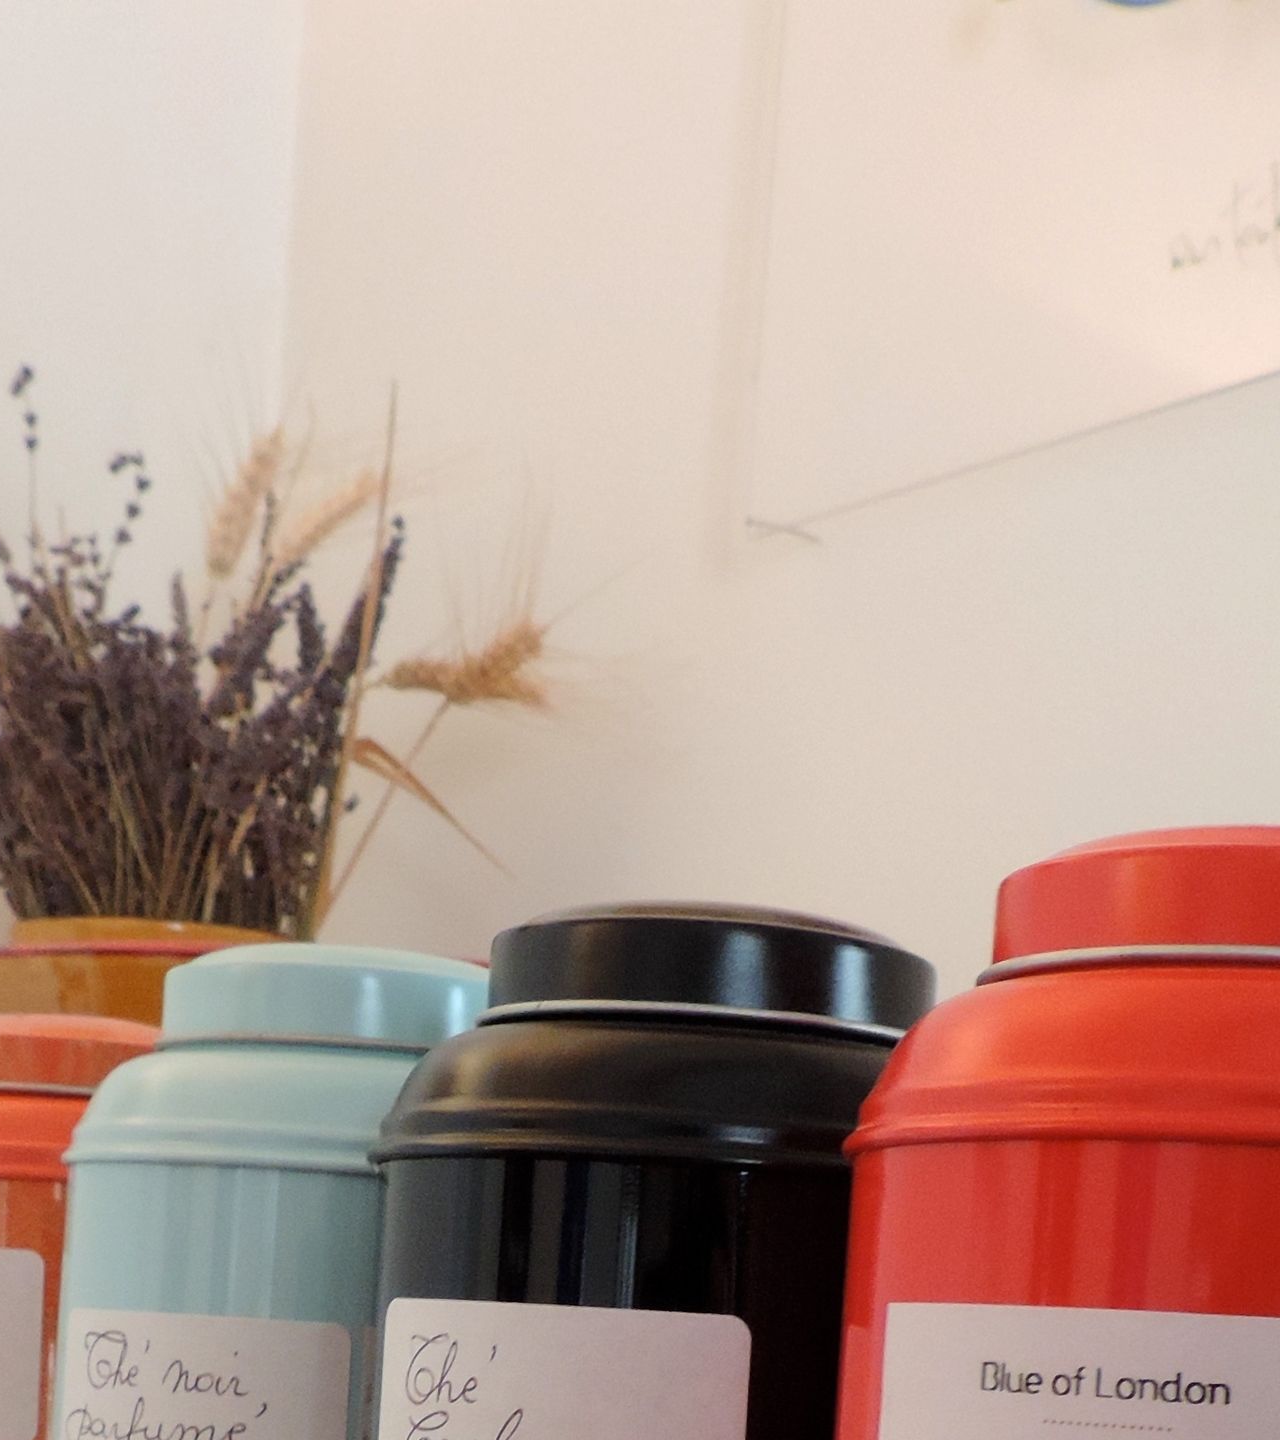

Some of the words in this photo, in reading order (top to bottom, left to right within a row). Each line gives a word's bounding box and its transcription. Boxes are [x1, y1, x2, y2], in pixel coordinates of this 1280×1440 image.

[84, 1330, 150, 1389] Thé
[162, 1351, 249, 1396] noir
[405, 1333, 498, 1405] Thé
[980, 1361, 1043, 1395] Blue
[1051, 1366, 1086, 1397] of
[1095, 1367, 1231, 1405] London
